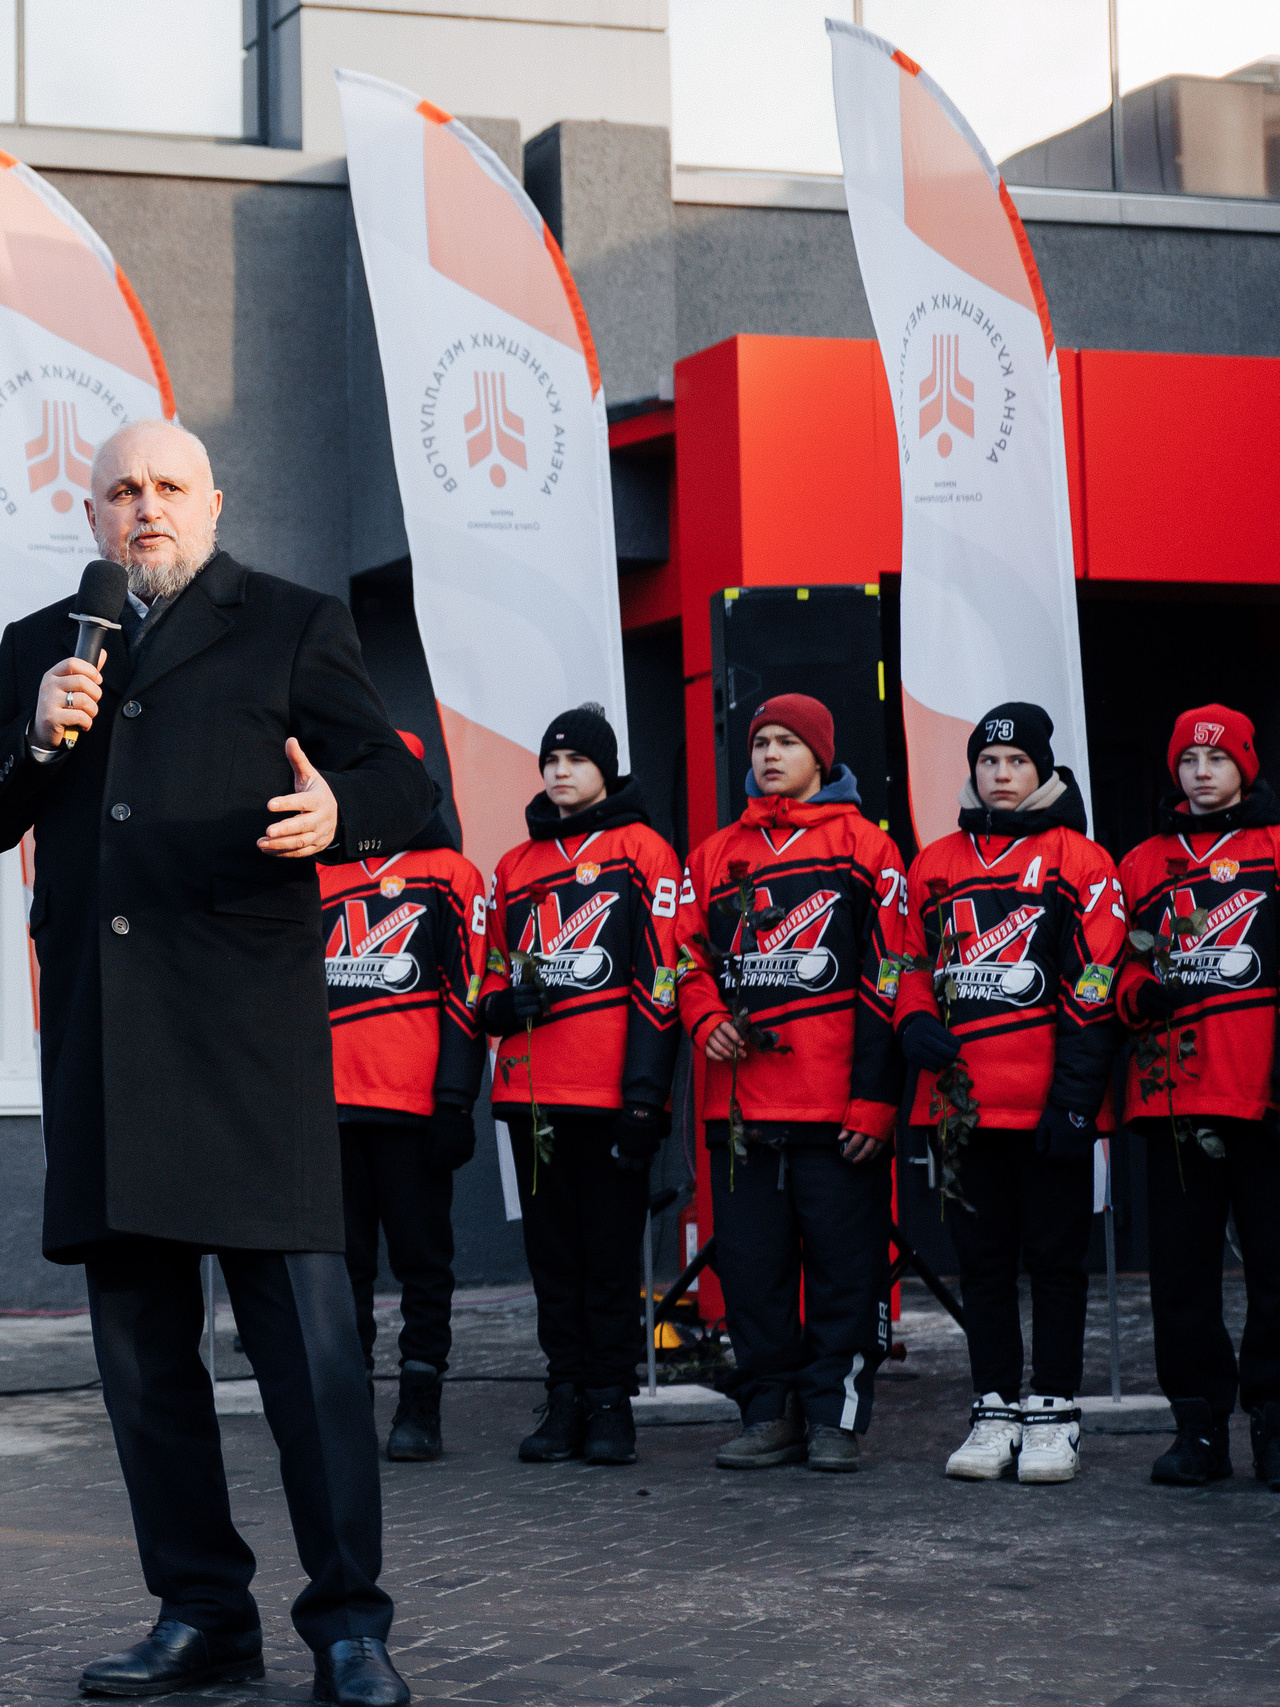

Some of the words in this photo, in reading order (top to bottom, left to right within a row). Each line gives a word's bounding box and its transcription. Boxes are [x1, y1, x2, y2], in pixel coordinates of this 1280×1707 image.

[985, 719, 1014, 742] 73
[1194, 722, 1225, 746] 57
[652, 877, 677, 918] 8
[1084, 876, 1126, 924] 73
